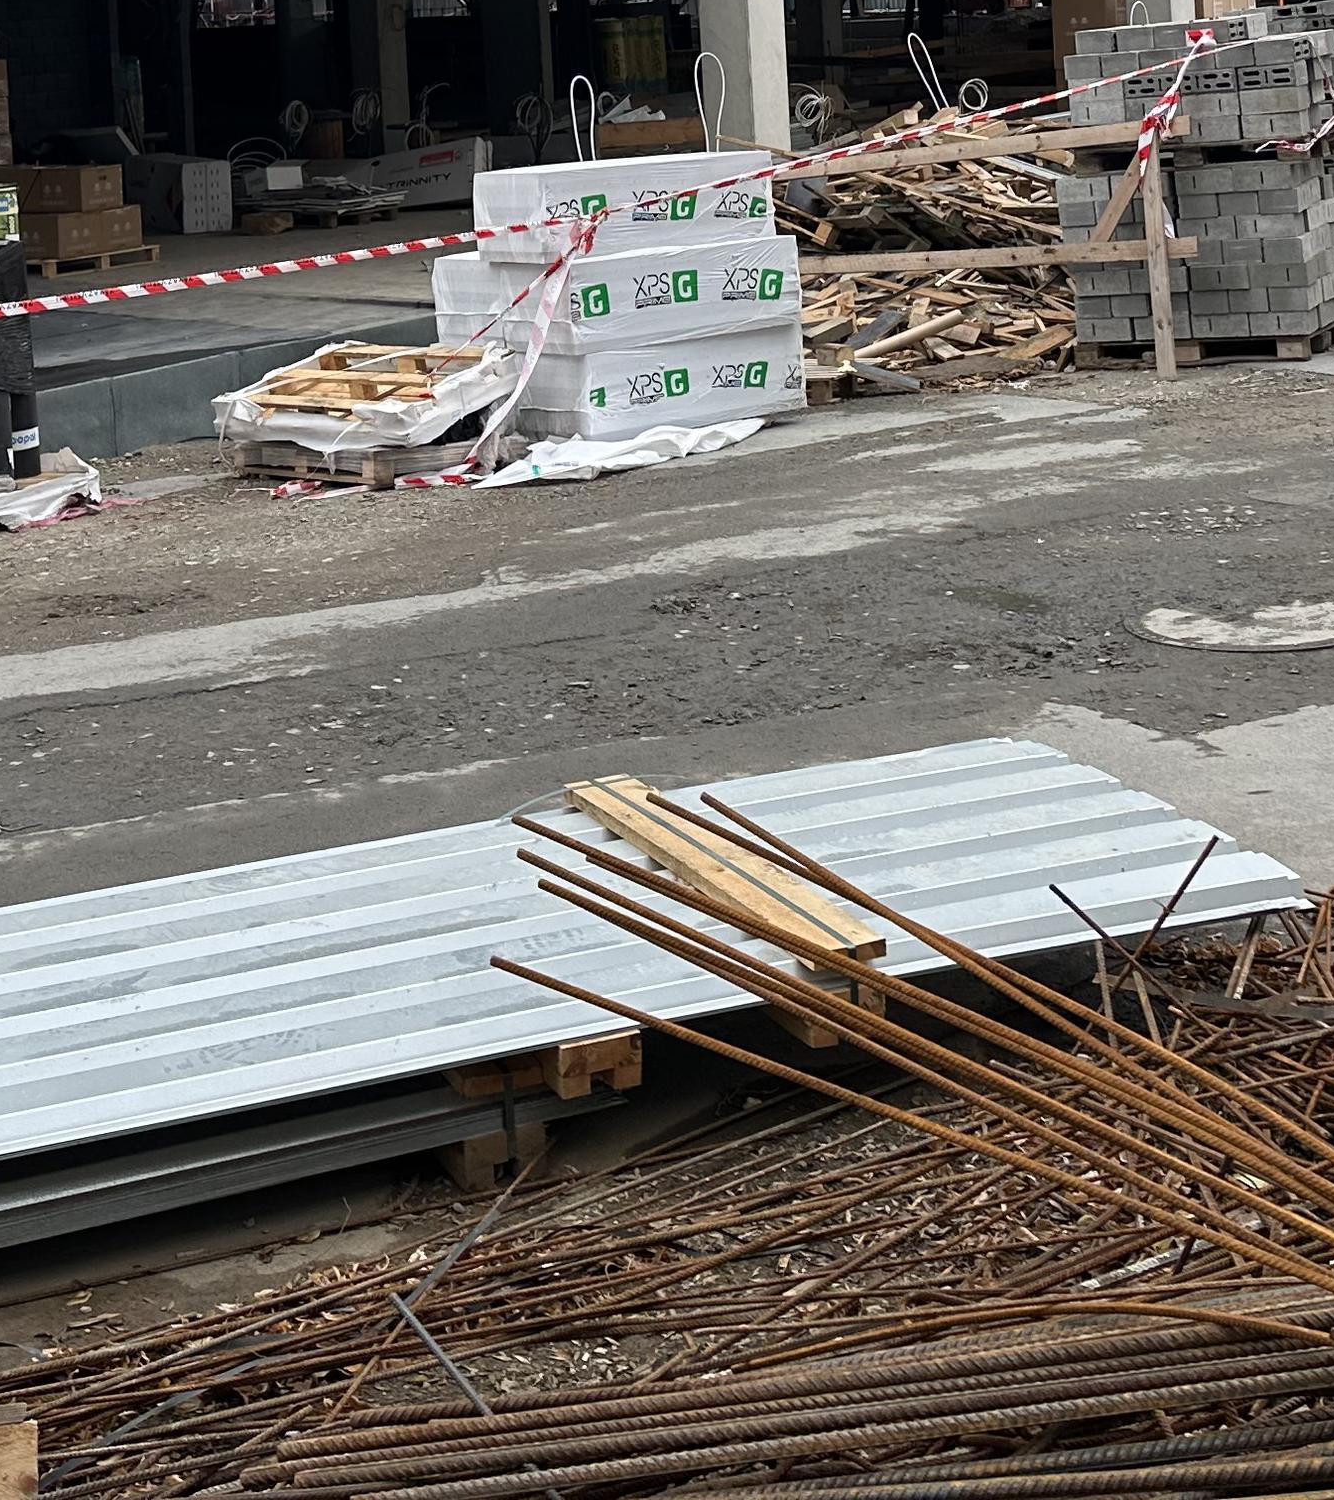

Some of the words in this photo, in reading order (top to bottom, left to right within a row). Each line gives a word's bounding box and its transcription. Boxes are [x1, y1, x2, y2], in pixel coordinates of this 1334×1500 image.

[388, 172, 451, 188] TRINNITY
[716, 191, 749, 212] XPS
[633, 272, 670, 299] XPS
[723, 268, 758, 291] XPS
[627, 372, 663, 398] XPS
[712, 364, 744, 387] XPS
